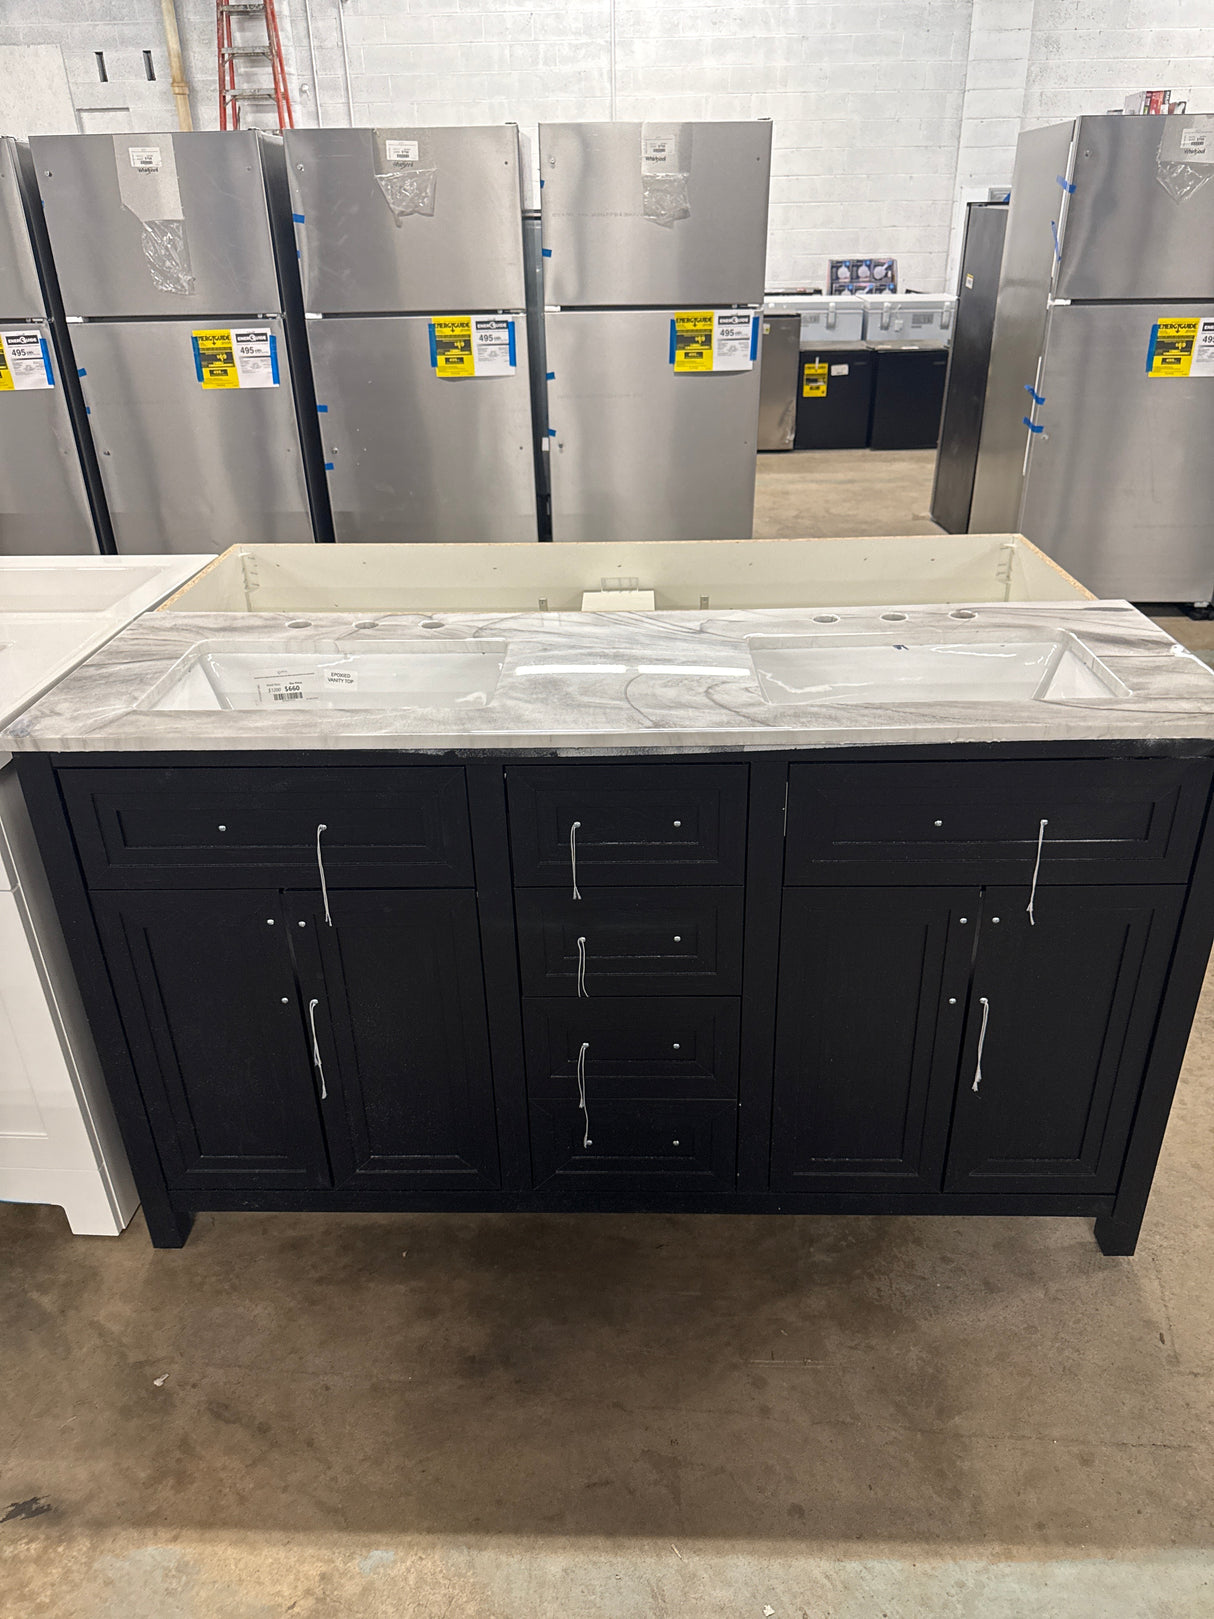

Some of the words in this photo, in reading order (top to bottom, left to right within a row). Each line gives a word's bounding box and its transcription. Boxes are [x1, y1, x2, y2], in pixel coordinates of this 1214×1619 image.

[479, 334, 494, 342] 495
[12, 348, 26, 356] 495
[240, 346, 255, 354] 495
